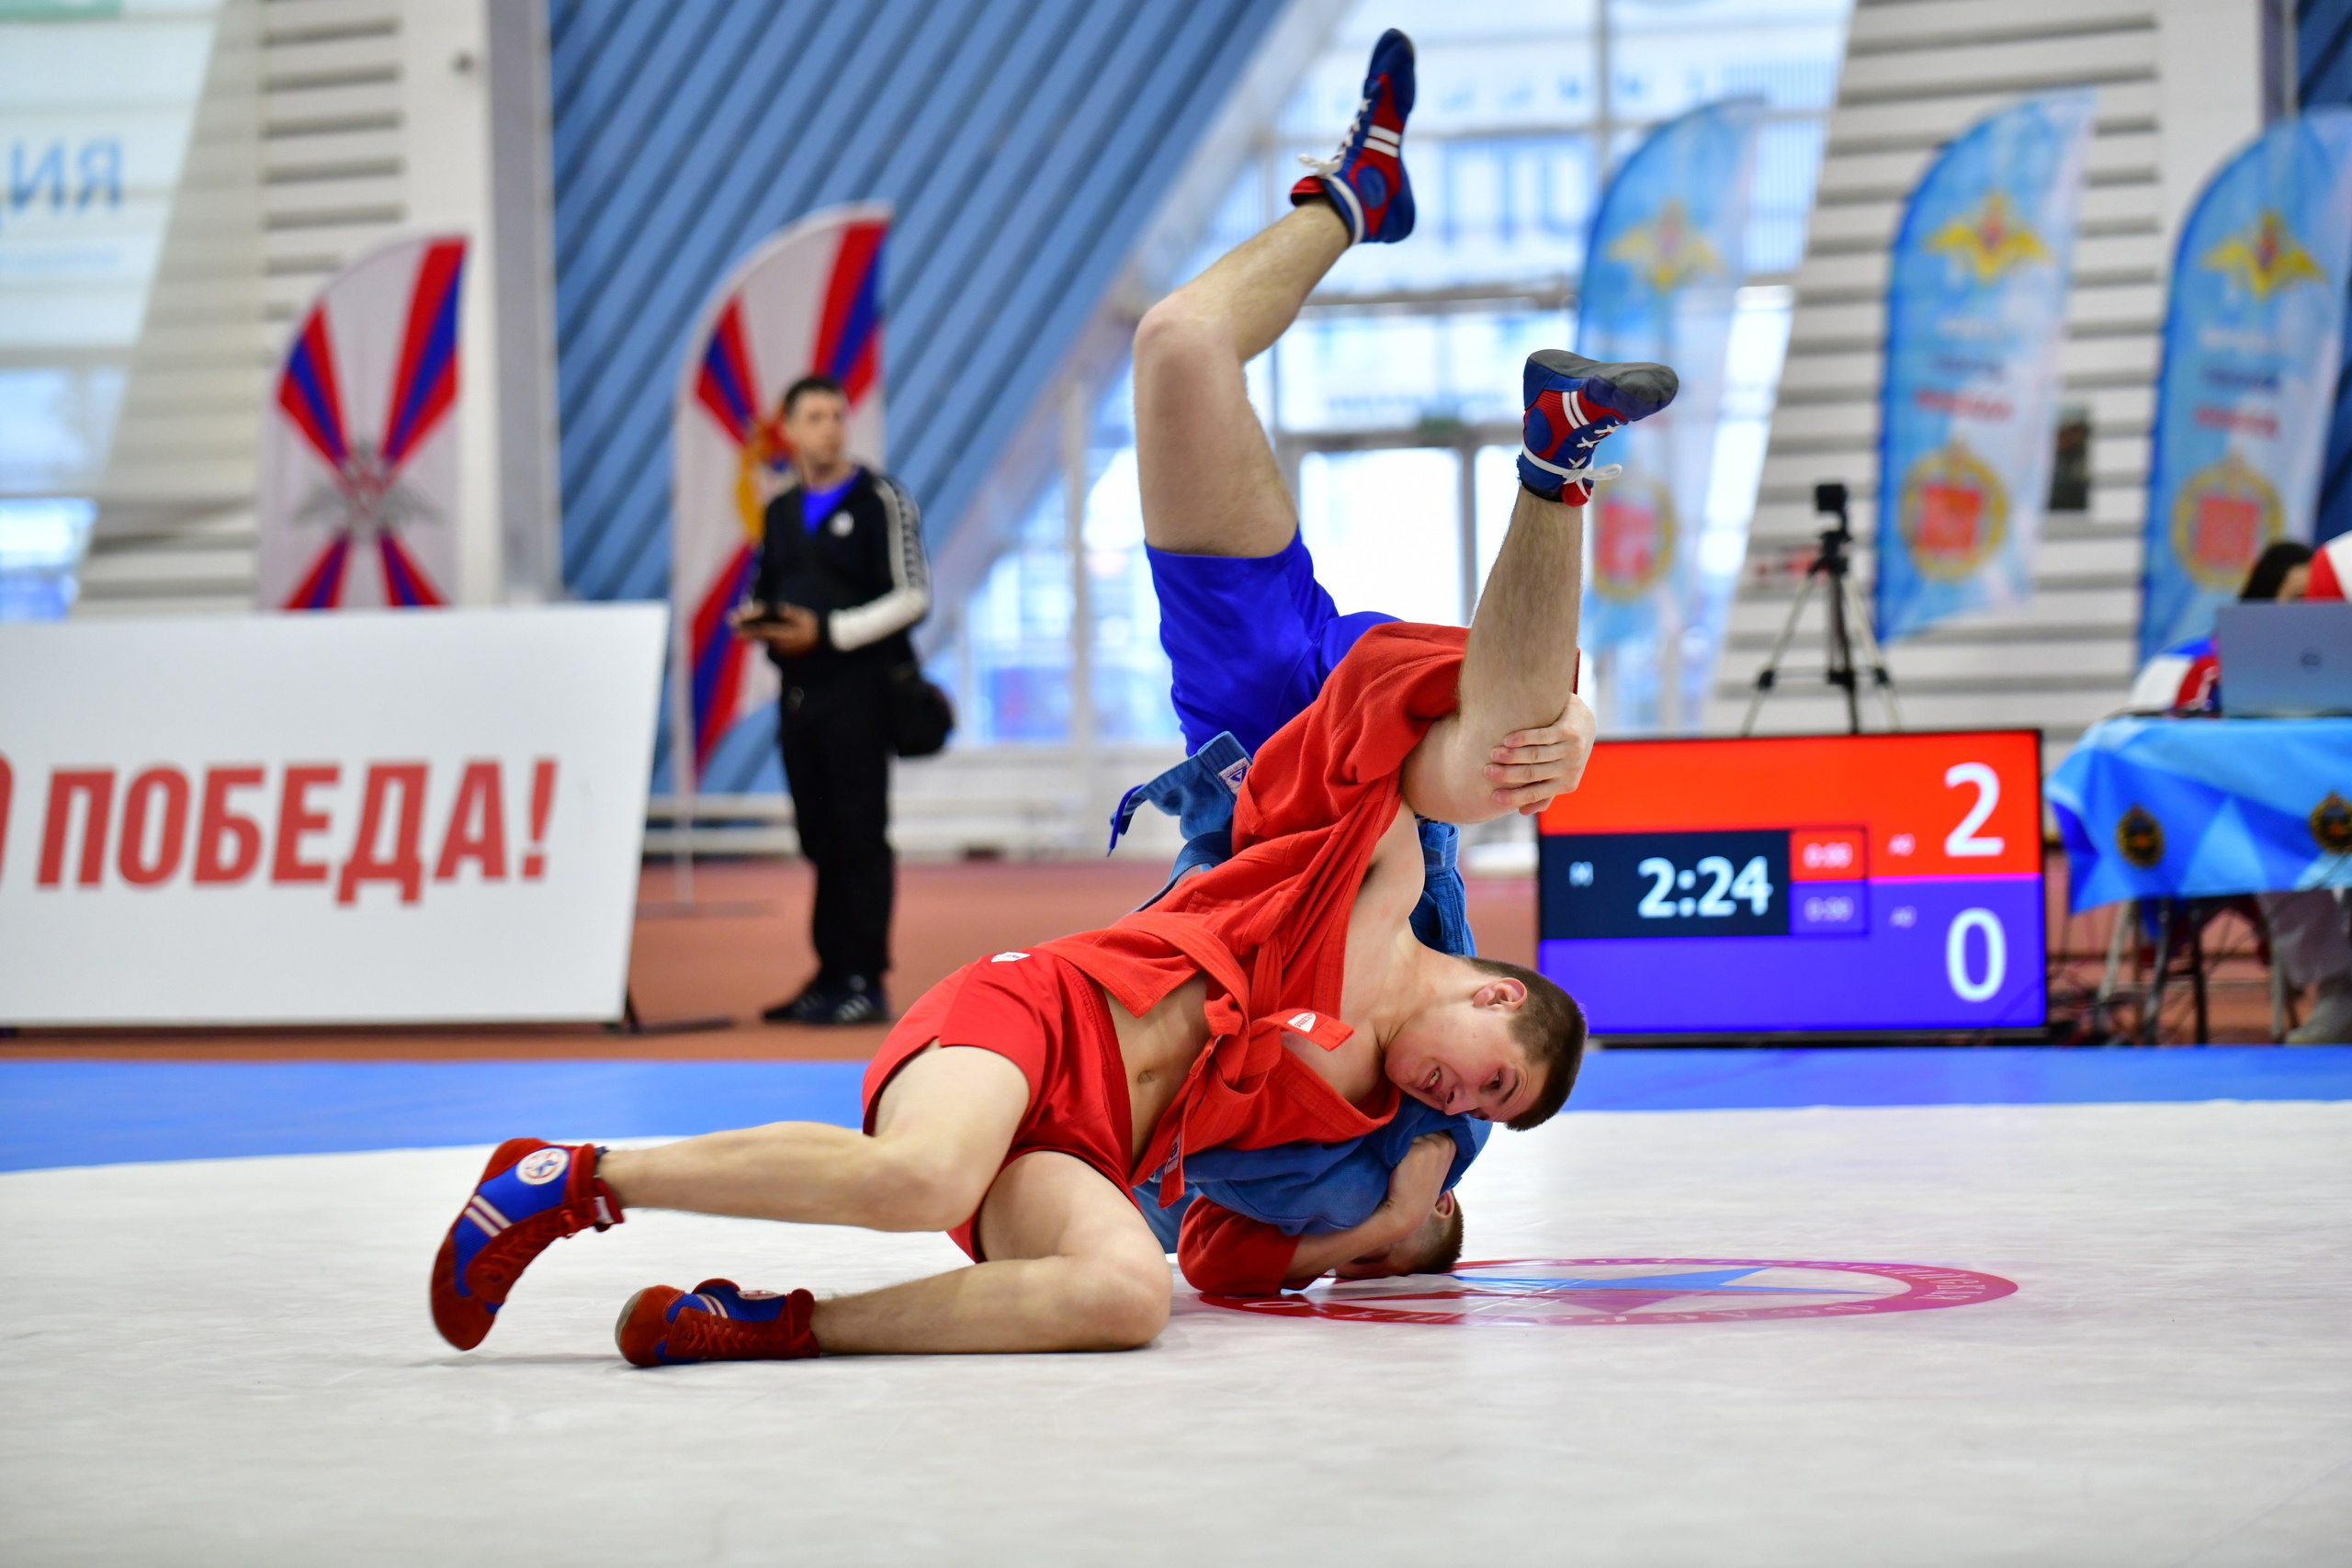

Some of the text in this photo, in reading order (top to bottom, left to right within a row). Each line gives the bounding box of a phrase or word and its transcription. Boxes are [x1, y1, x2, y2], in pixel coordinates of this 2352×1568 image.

[0, 136, 124, 217] ИЯ
[35, 753, 559, 907] ПОБЕДА!
[1943, 761, 2006, 858] 2
[1637, 855, 1773, 919] 2:24
[1946, 907, 2007, 1003] 0
